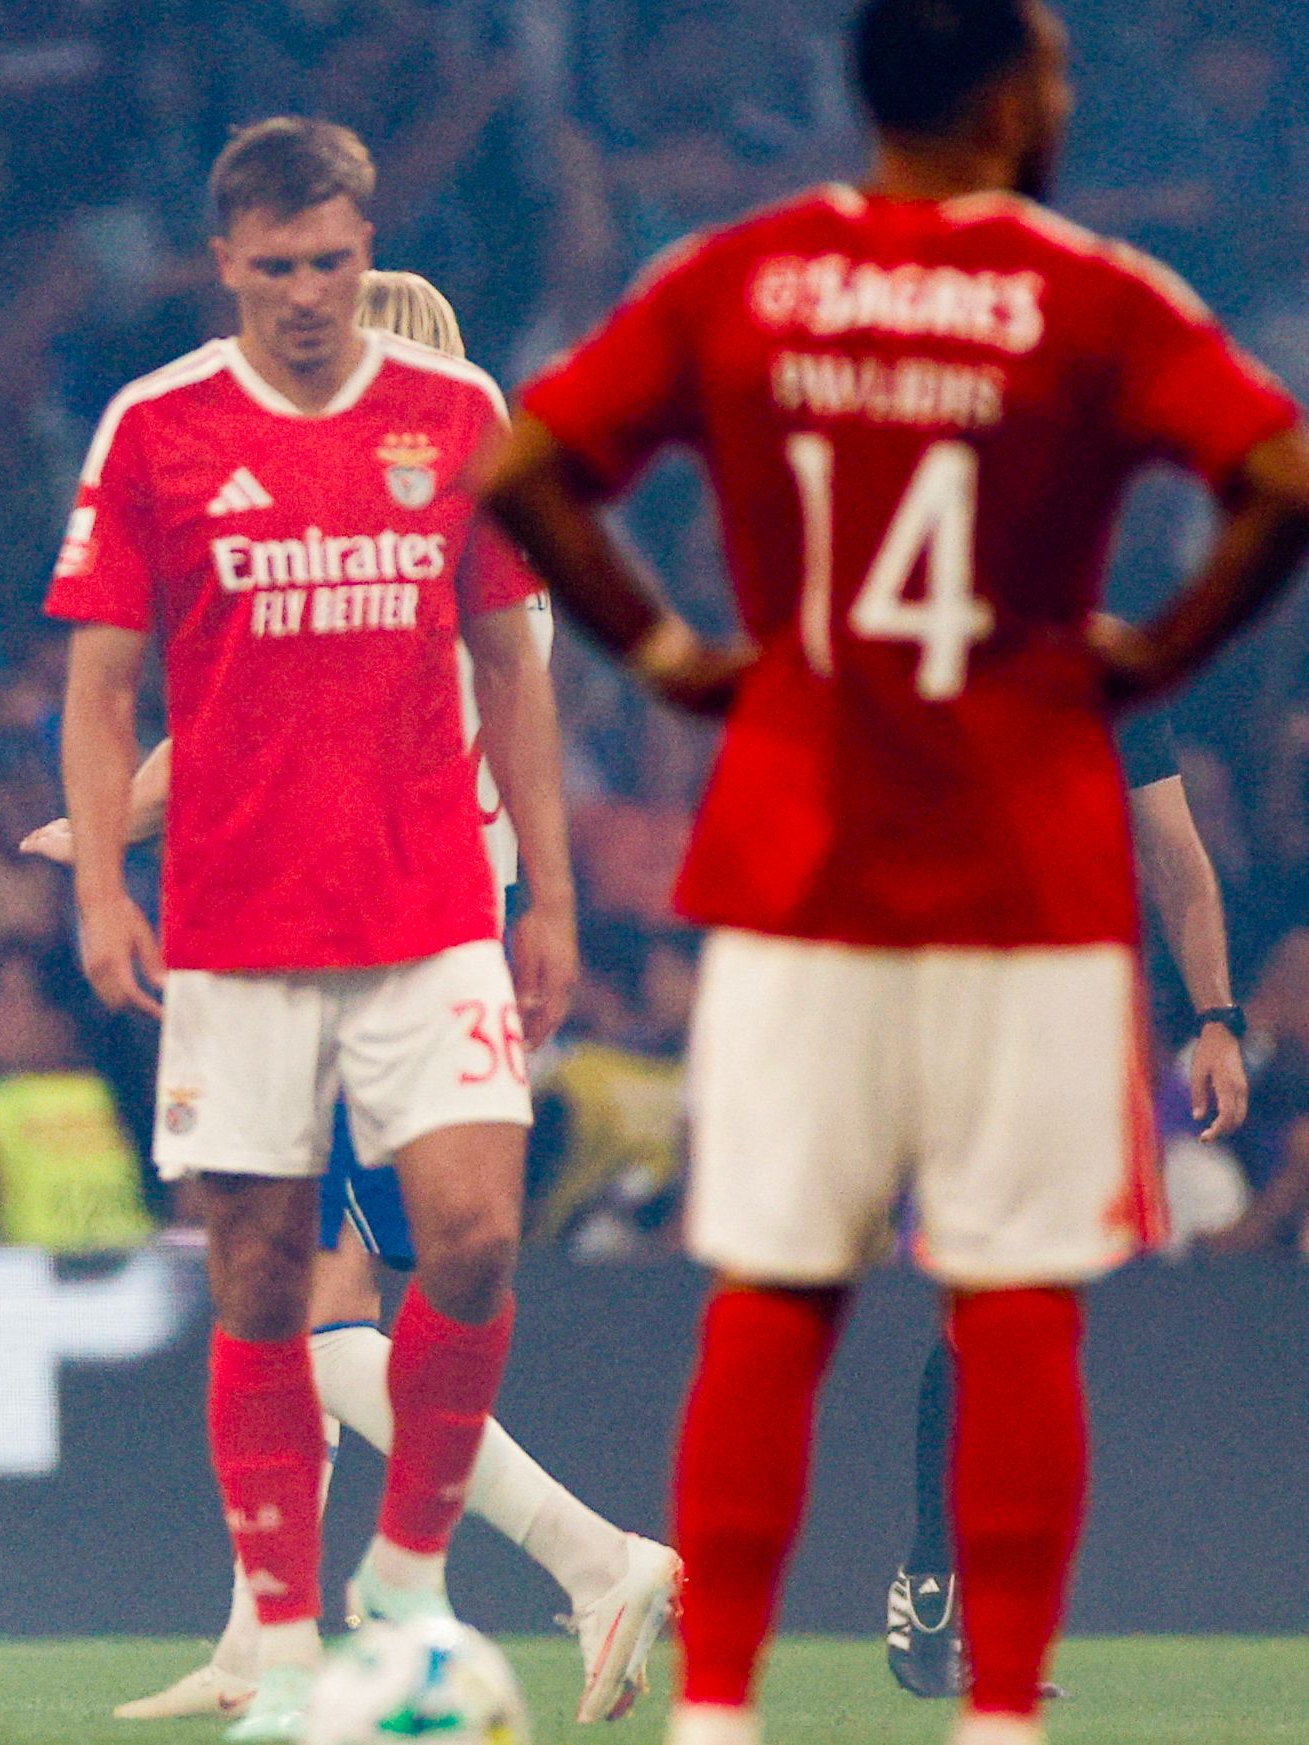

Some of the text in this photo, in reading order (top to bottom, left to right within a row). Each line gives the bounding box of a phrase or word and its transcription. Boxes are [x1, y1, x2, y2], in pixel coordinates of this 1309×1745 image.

[211, 526, 446, 593] Emirates
[786, 430, 995, 701] 14
[251, 583, 419, 638] FLY BETTER
[450, 998, 528, 1087] 36
